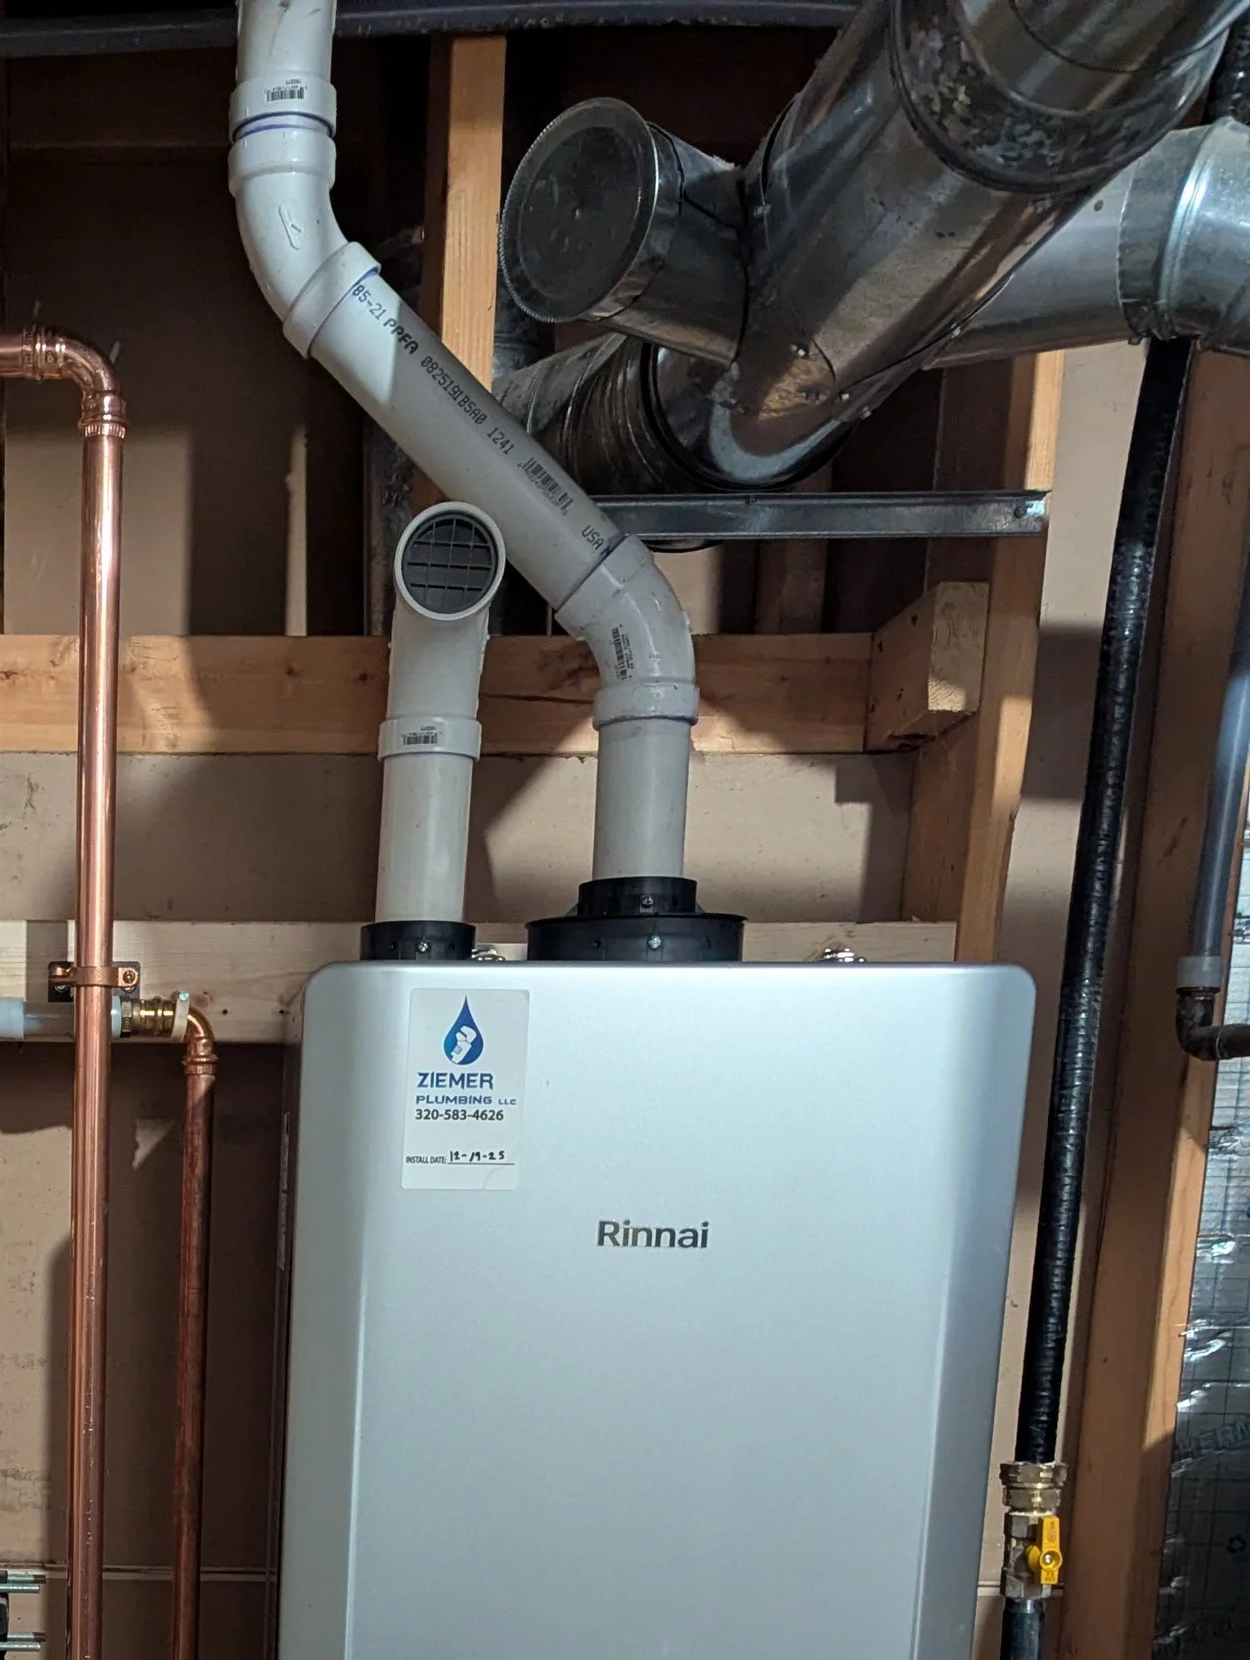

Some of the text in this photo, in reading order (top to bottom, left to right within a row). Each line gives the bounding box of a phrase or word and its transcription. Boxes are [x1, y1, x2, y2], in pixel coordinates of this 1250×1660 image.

[383, 318, 419, 355] PPFA
[487, 427, 515, 455] 1241
[581, 525, 605, 550] USA
[417, 1072, 494, 1089] ZIEMER
[415, 1095, 493, 1105] PLUMBING
[415, 1109, 504, 1121] 320-583-4626
[406, 1156, 447, 1164] INSTALL DATE:
[597, 1219, 709, 1249] Rinnai
